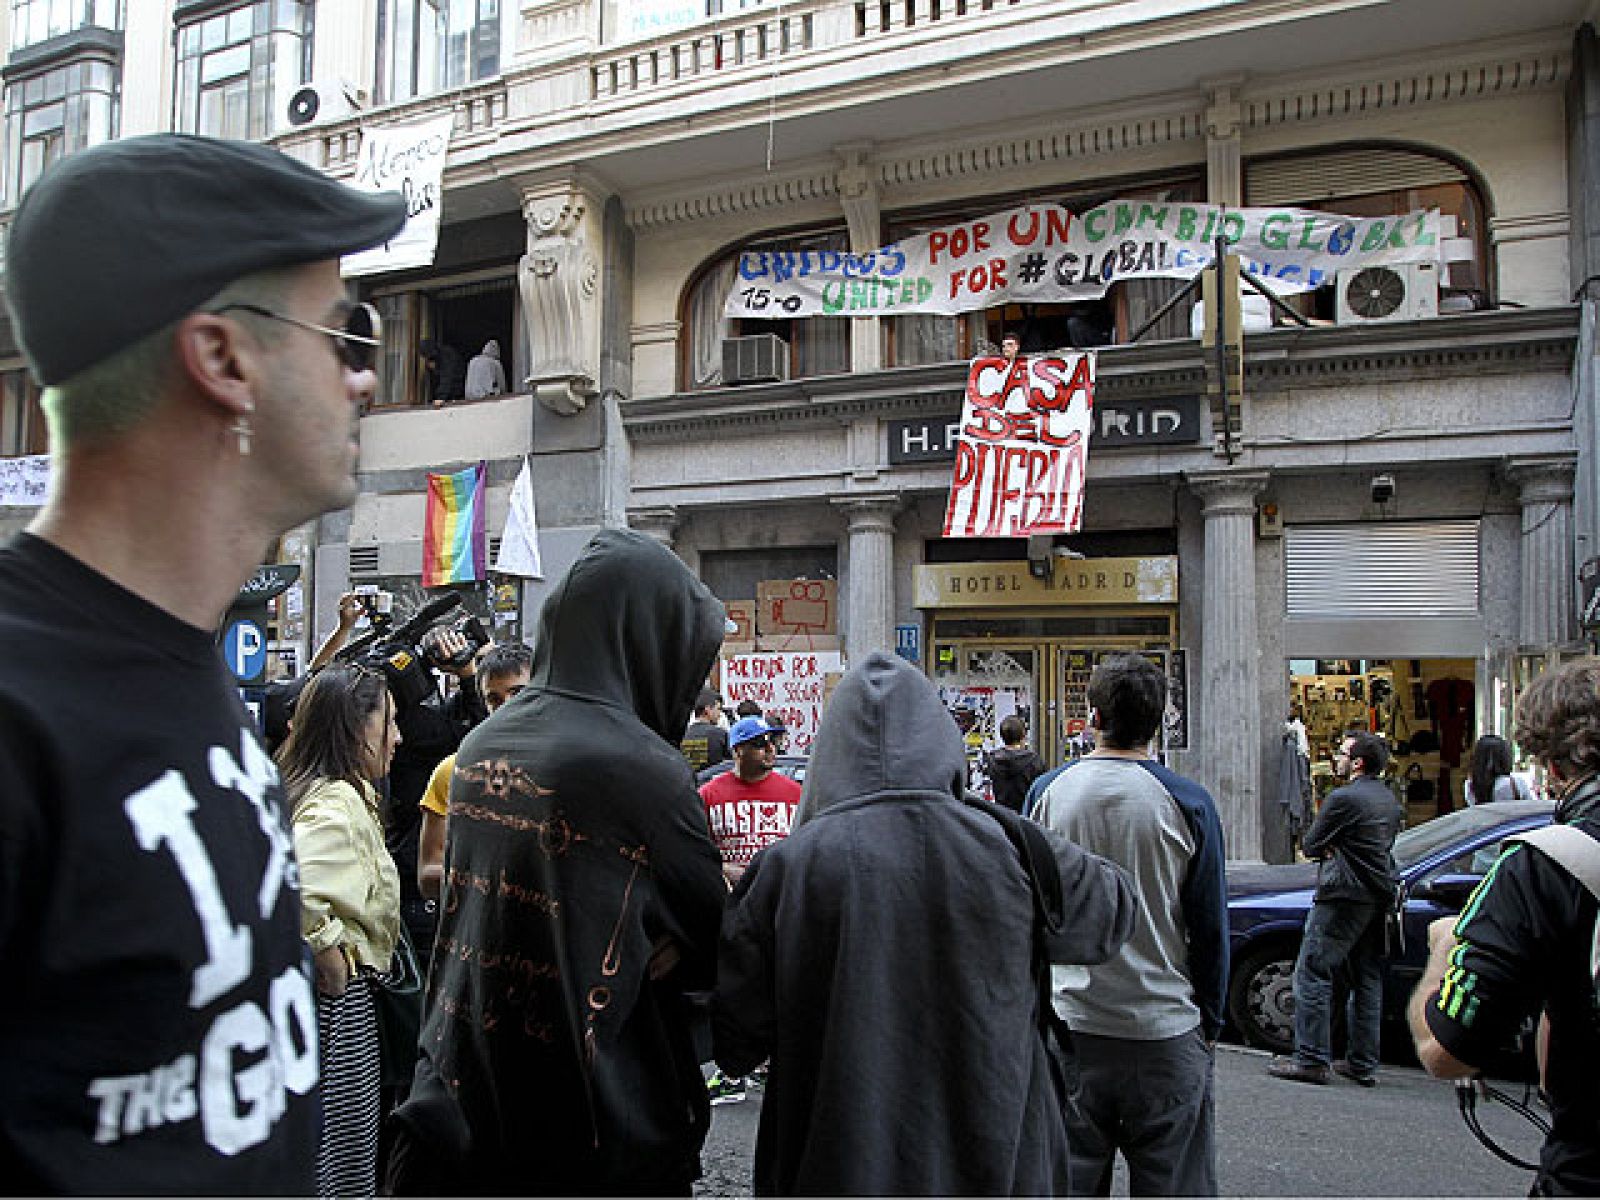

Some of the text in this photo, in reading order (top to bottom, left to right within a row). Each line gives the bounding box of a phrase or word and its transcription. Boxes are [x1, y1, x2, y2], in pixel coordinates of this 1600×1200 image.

[928, 222, 991, 265] POR
[1006, 207, 1074, 246] UN
[1083, 203, 1246, 245] CAMBIO
[1260, 211, 1436, 256] GLOBAL
[949, 256, 1009, 299] FOR
[968, 354, 1095, 412] CASA
[964, 410, 1082, 447] DEL
[950, 575, 1021, 594] HOTEL
[236, 623, 262, 677] P
